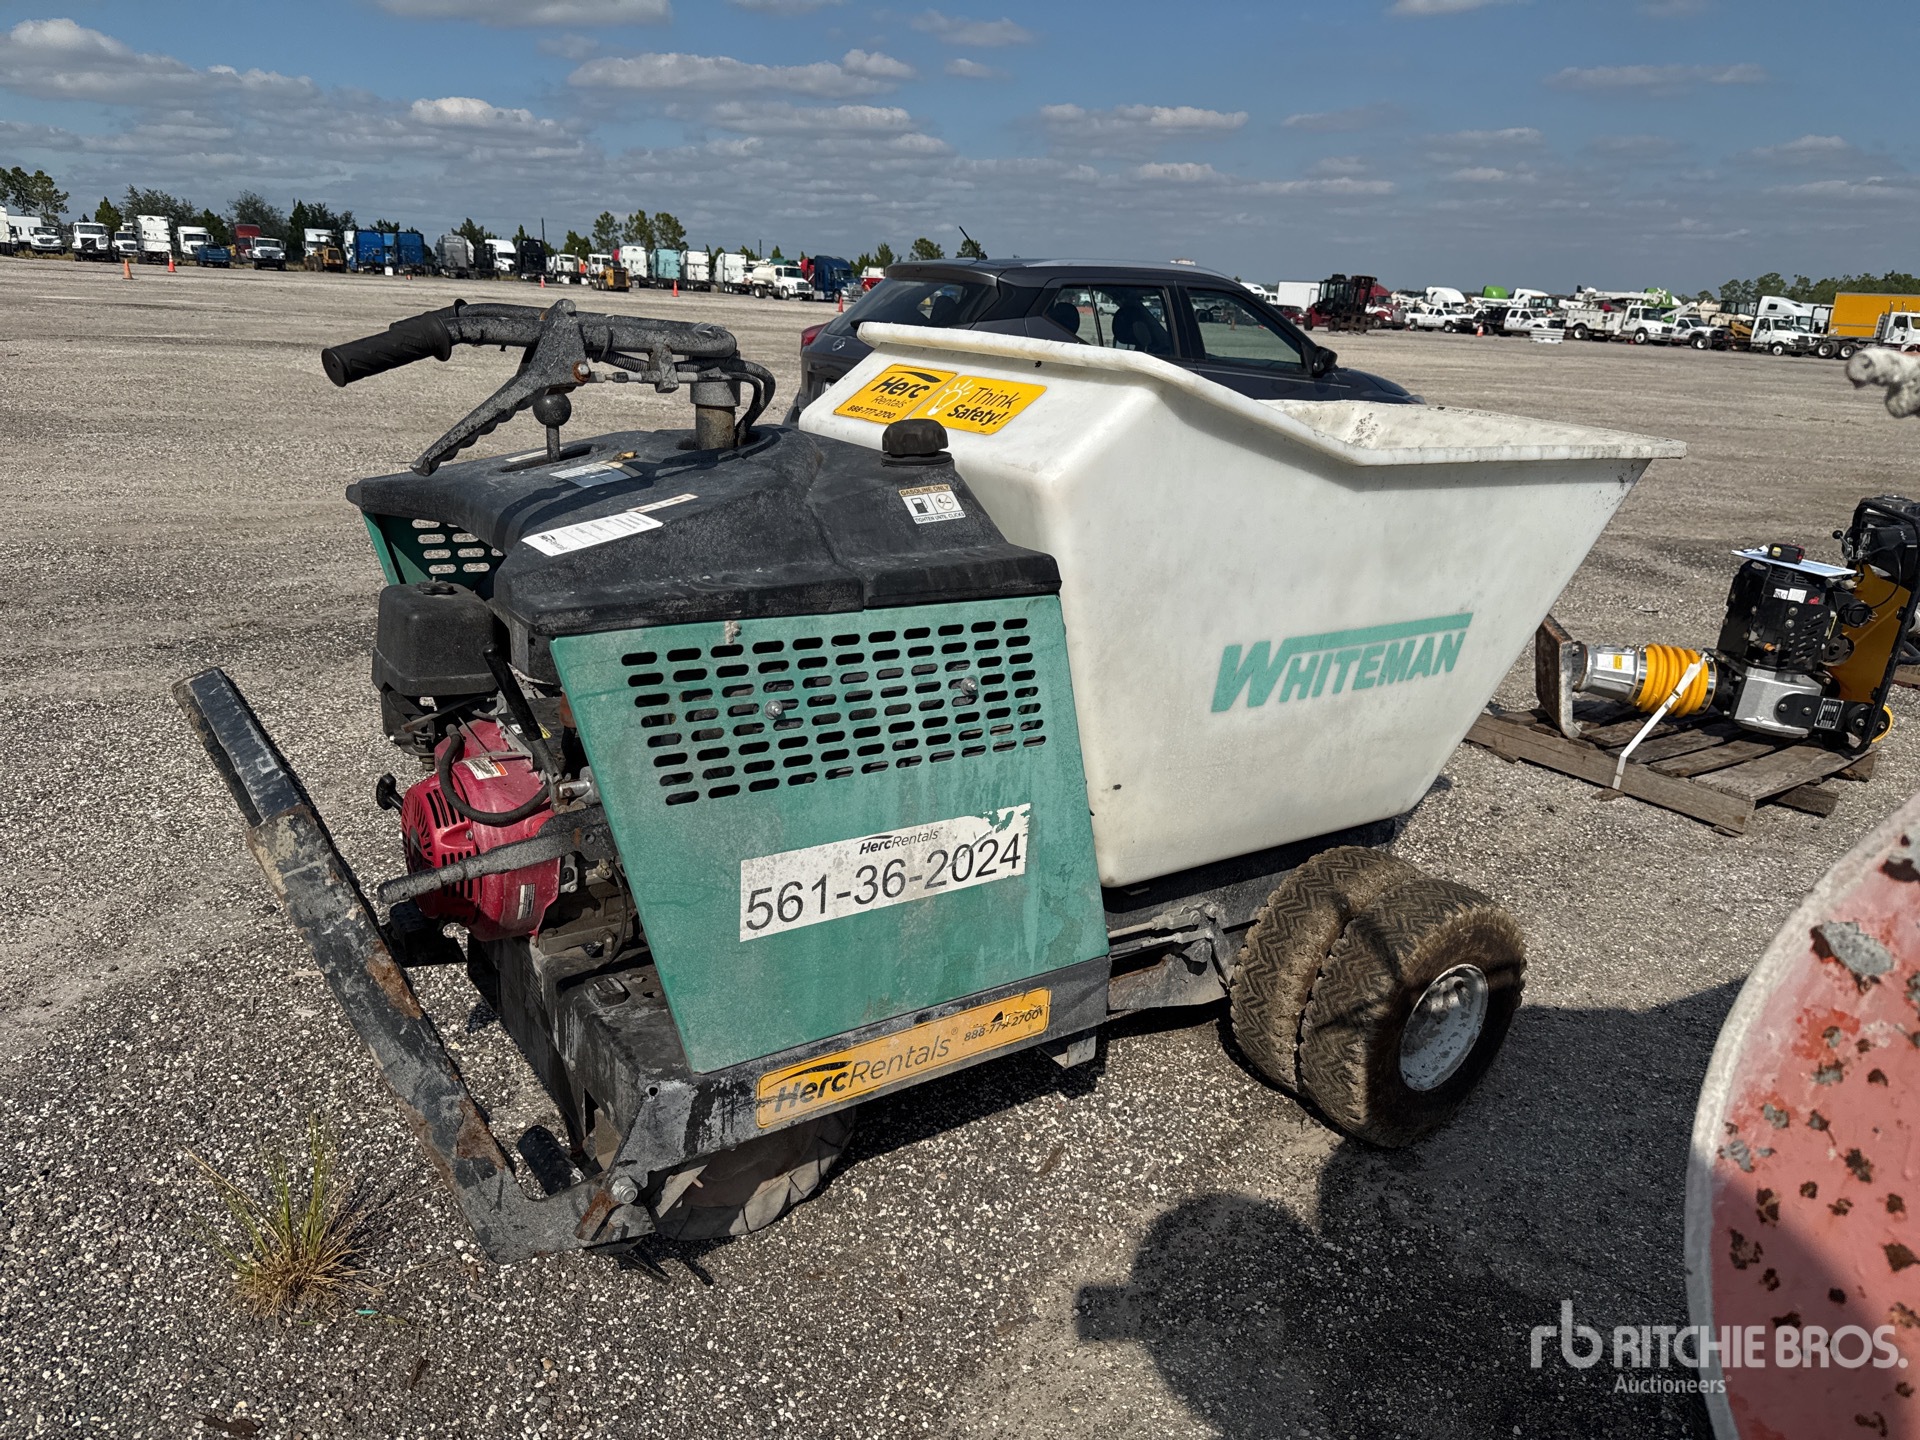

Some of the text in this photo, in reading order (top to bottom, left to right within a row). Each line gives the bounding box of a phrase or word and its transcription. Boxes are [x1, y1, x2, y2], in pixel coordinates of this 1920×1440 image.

[871, 376, 930, 399] Herc
[967, 387, 1020, 410] Think
[847, 405, 897, 419] 888-777-2700
[872, 395, 909, 409] Rentals
[947, 403, 1007, 427] Safety!
[900, 486, 932, 496] GASOLINE
[1211, 612, 1474, 713] WHITEMAN
[859, 829, 939, 855] HercRentals
[746, 833, 1021, 931] 561-36-2024
[774, 1034, 952, 1114] HercRentals
